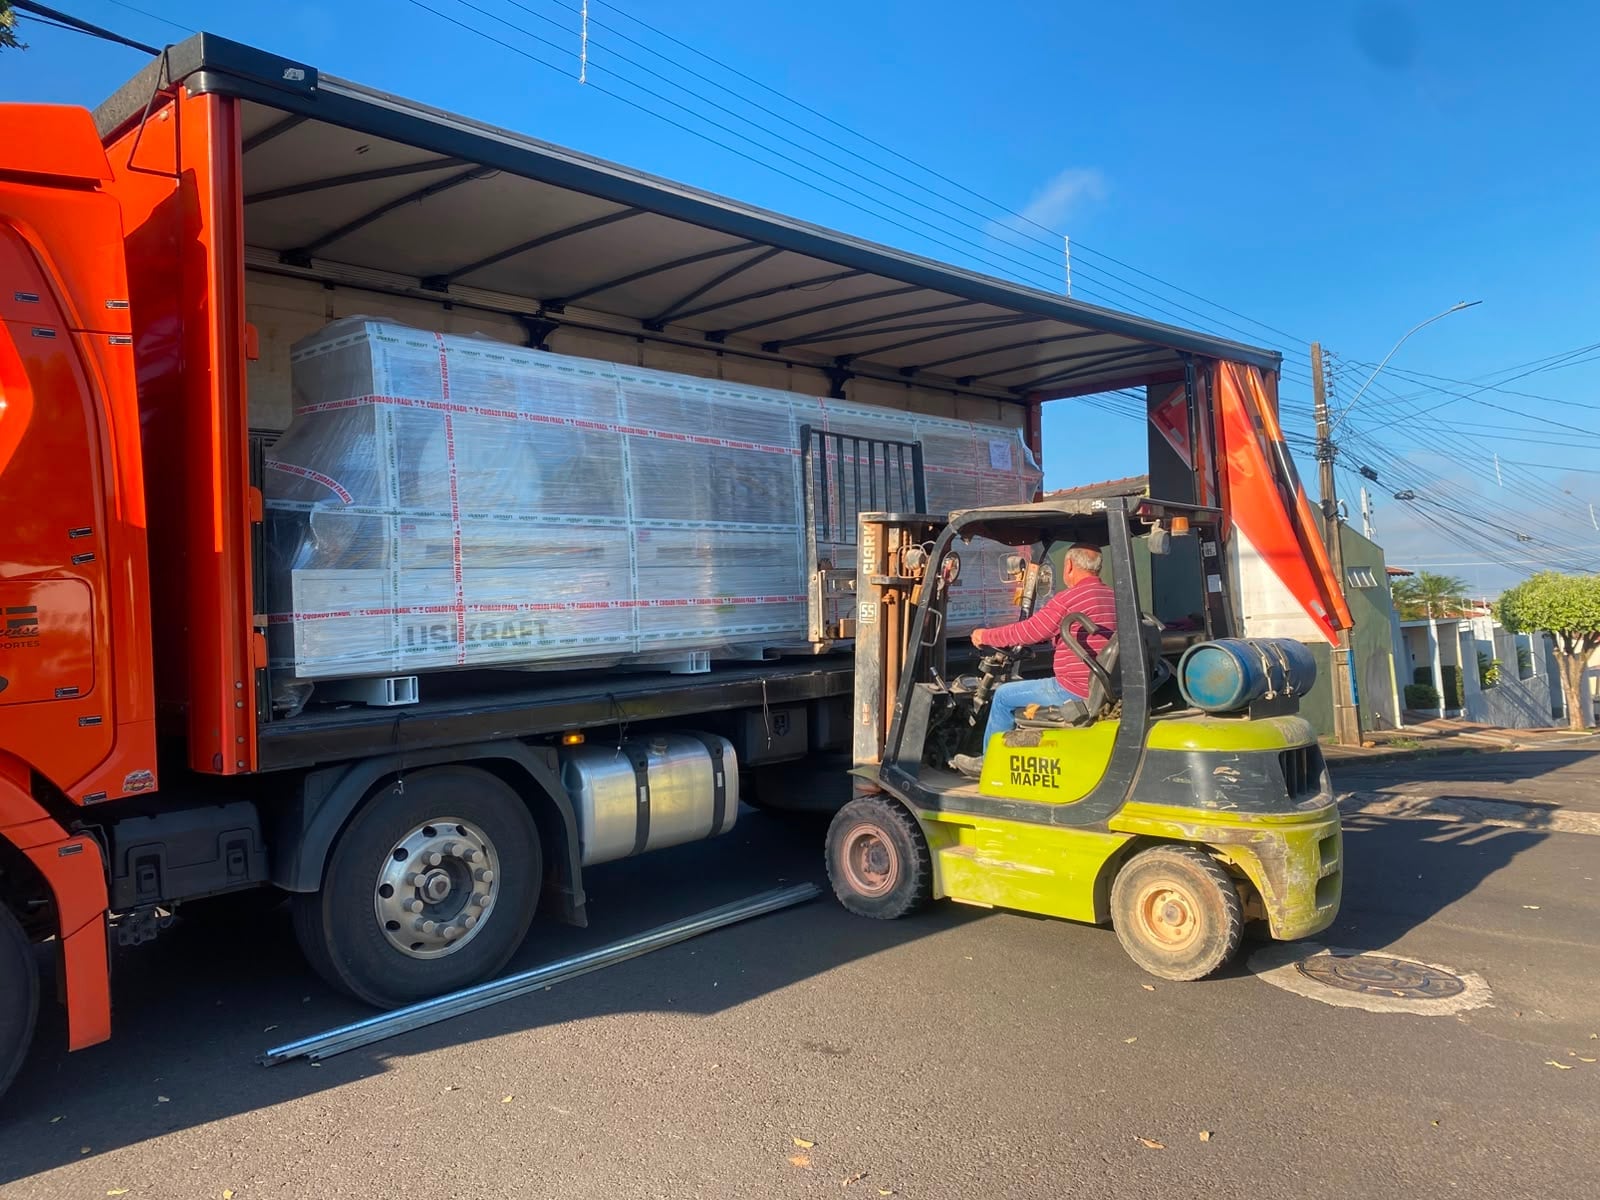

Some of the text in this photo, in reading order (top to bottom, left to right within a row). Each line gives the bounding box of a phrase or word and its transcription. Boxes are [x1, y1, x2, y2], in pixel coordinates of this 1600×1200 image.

[863, 524, 876, 574] CLARK
[1010, 755, 1061, 775] CLARK
[1010, 772, 1060, 789] MAPEL
